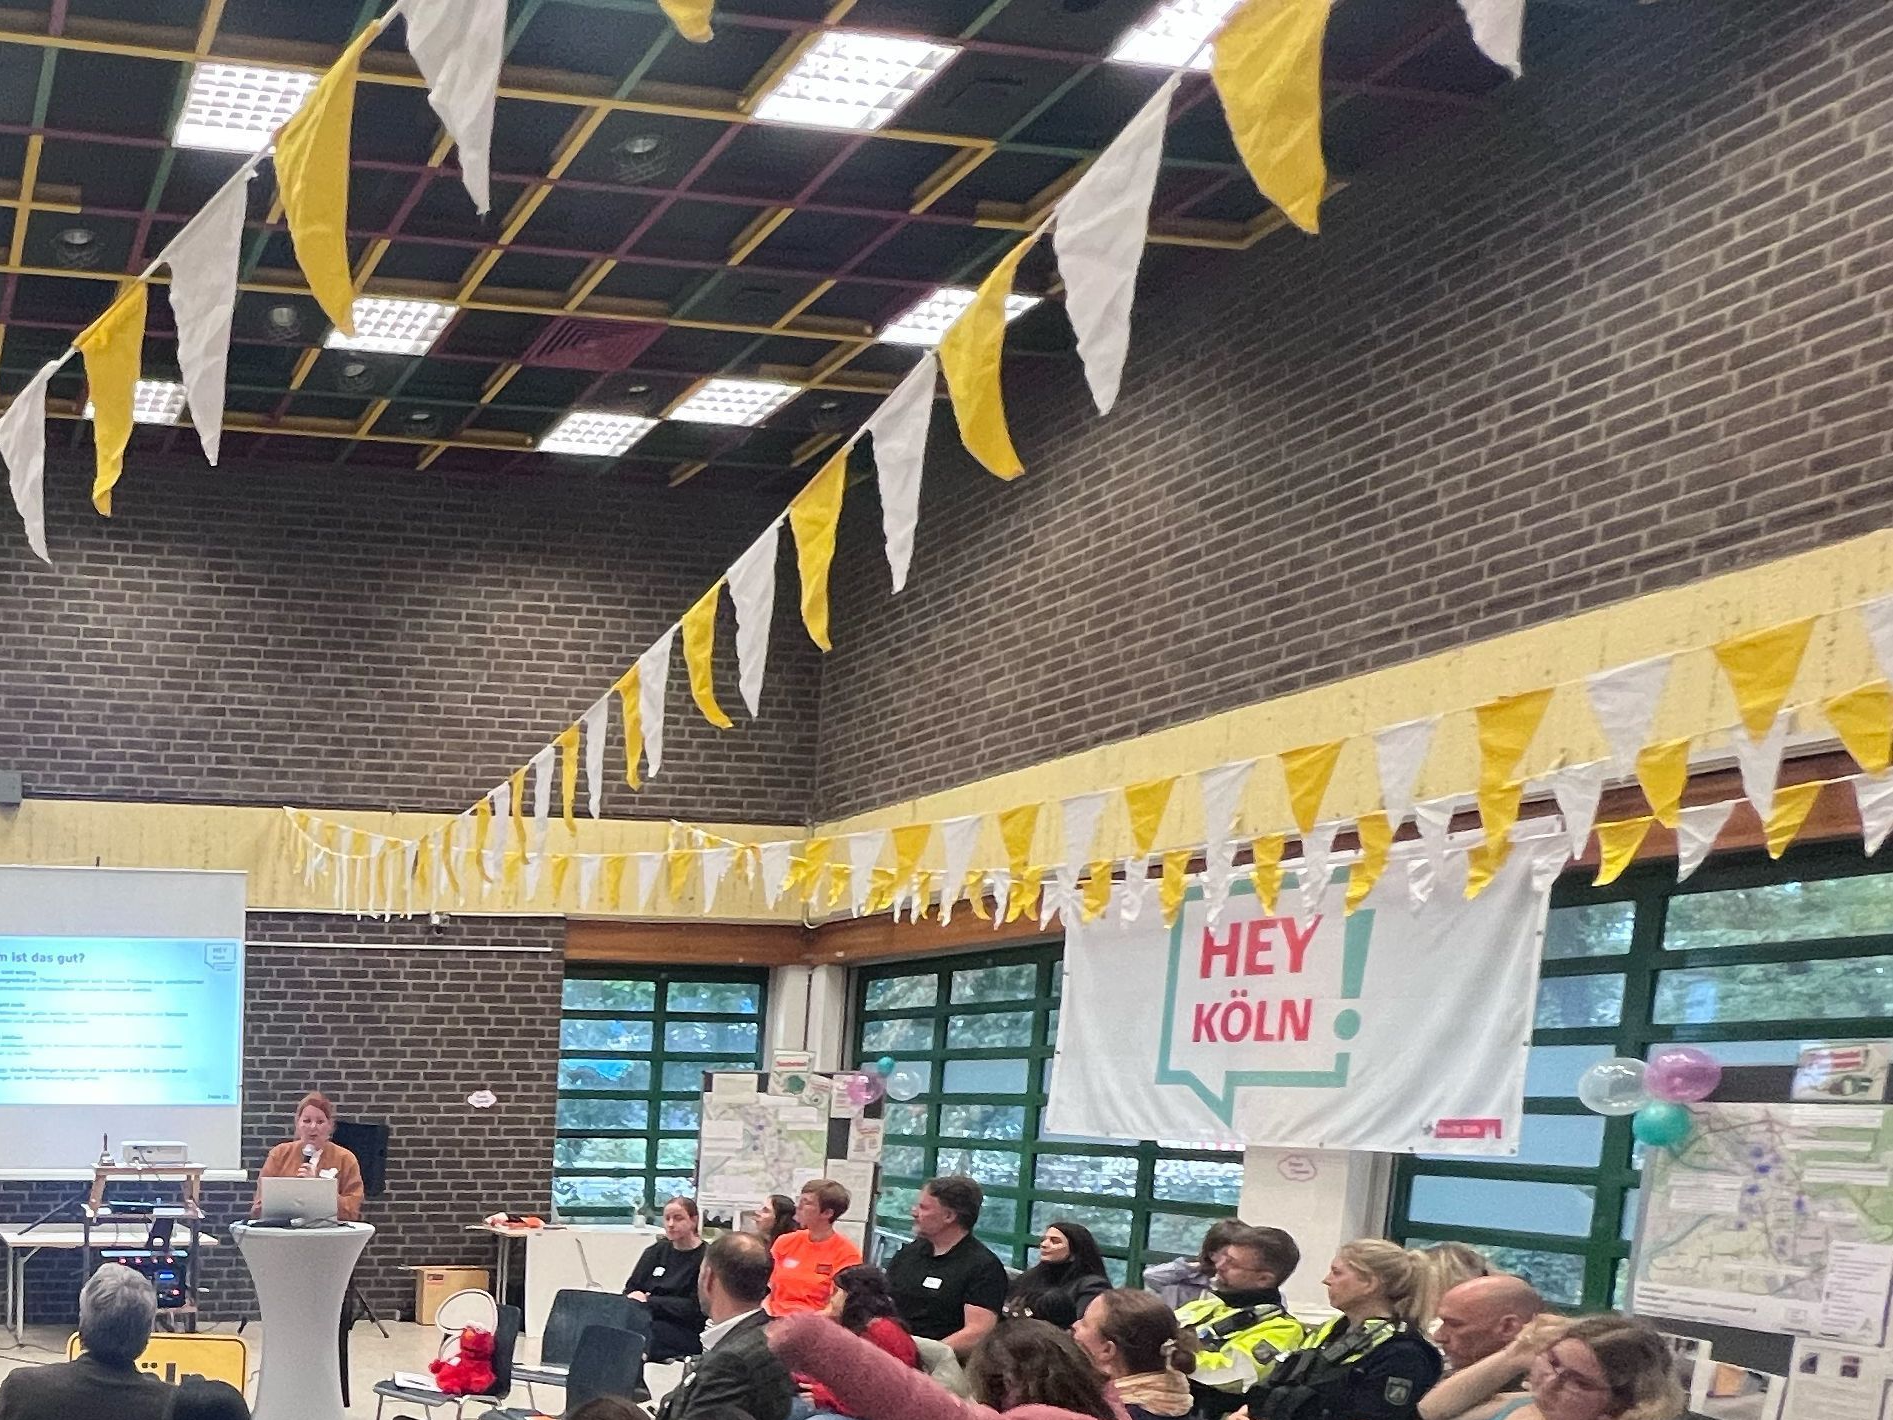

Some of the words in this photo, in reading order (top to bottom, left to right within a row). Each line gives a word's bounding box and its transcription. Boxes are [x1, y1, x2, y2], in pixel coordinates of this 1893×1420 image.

[11, 951, 28, 963] ist
[31, 952, 54, 963] das
[57, 953, 86, 965] gut?
[1199, 912, 1324, 979] HEY
[1192, 988, 1313, 1043] KÖLN
